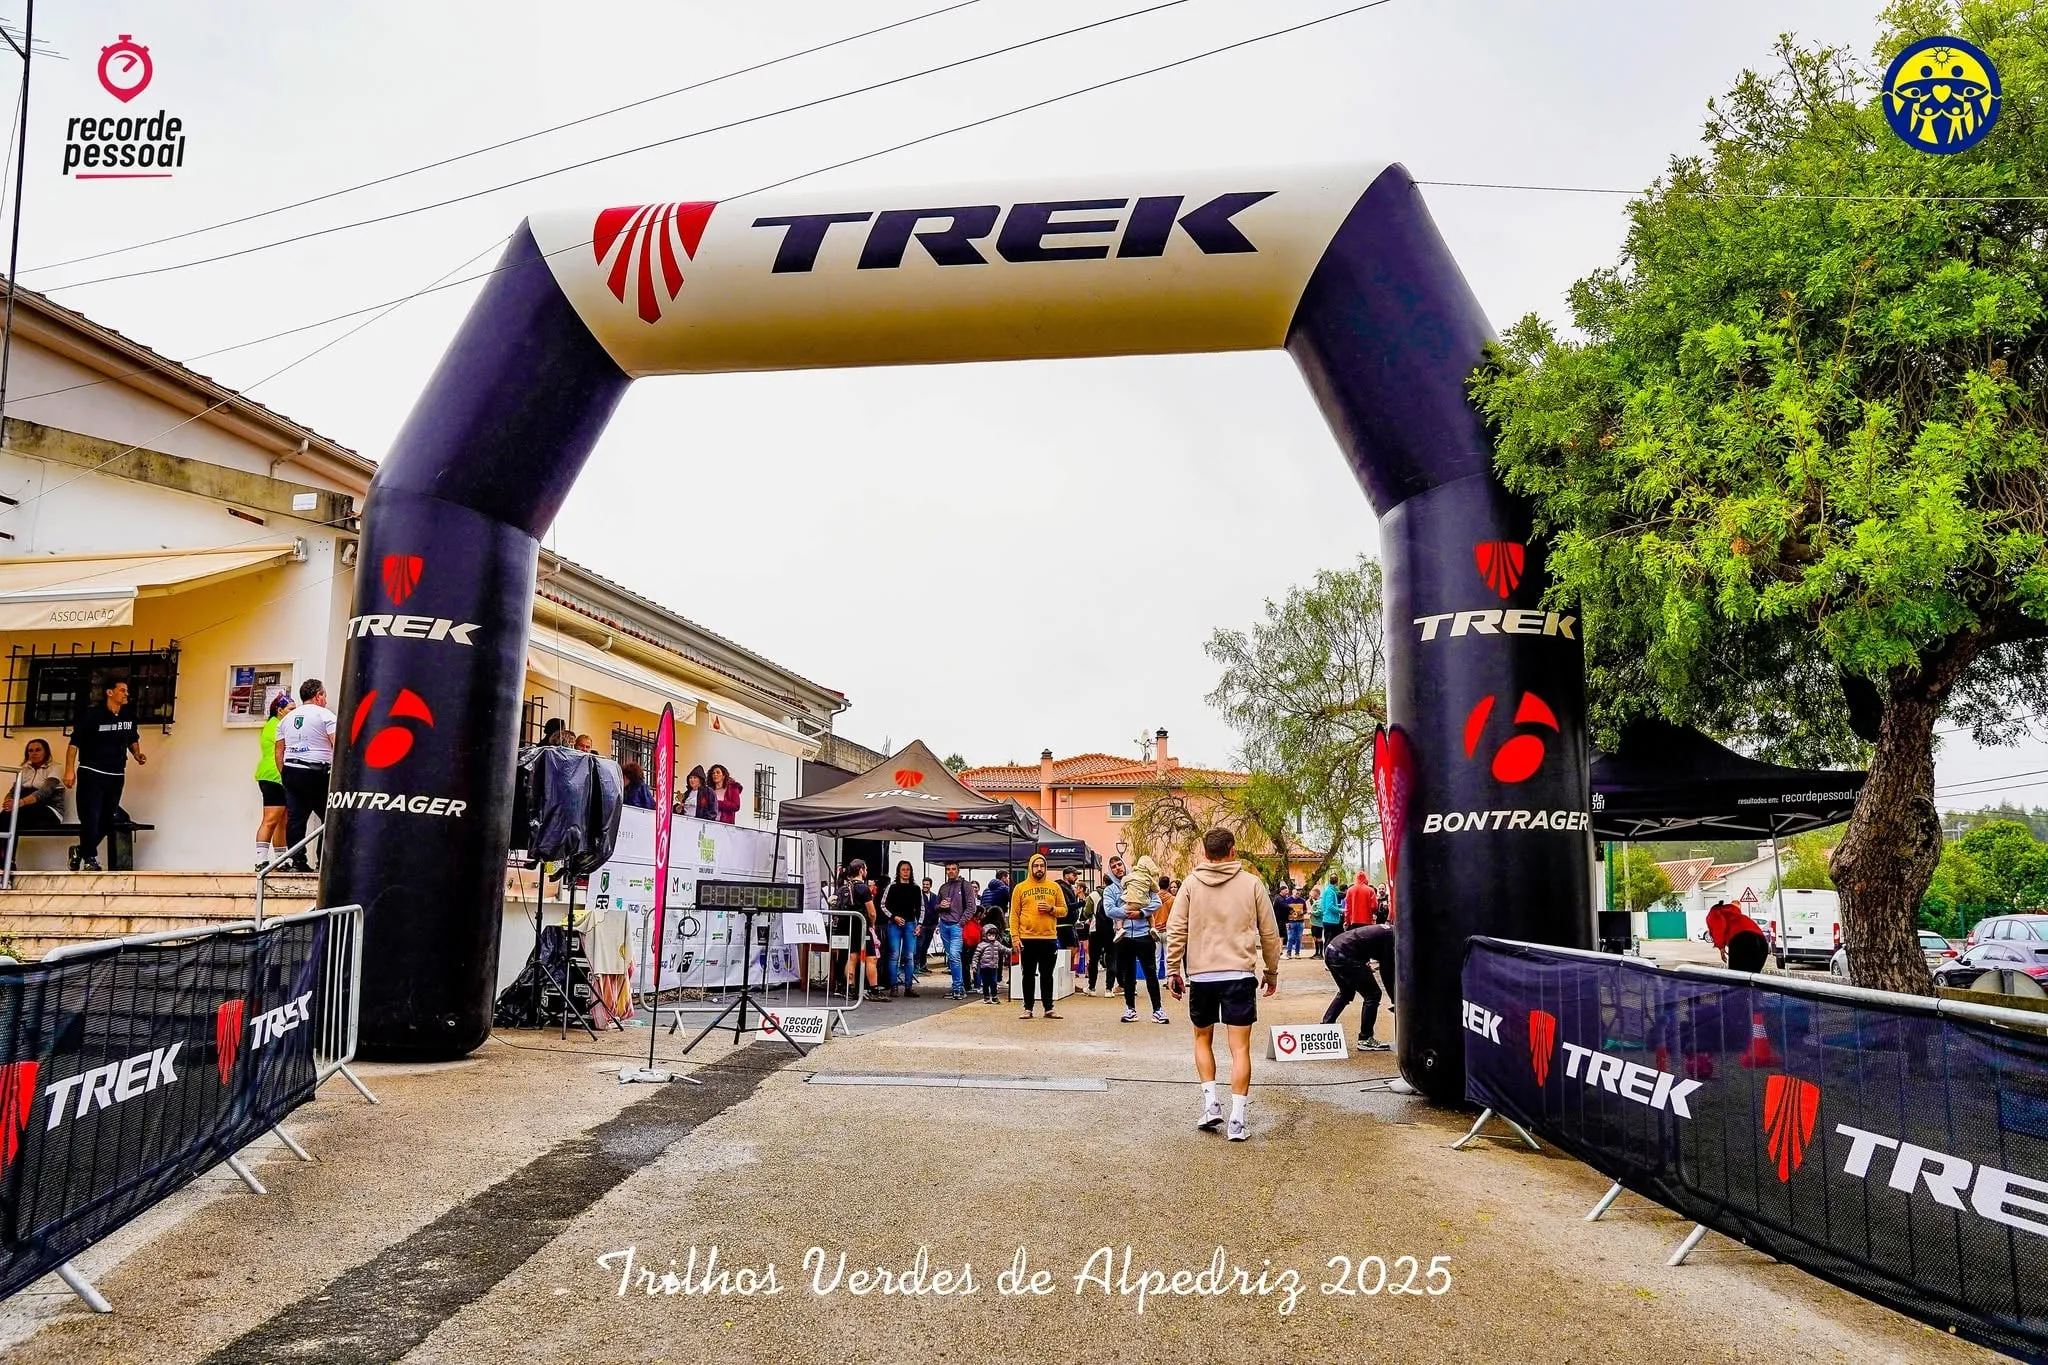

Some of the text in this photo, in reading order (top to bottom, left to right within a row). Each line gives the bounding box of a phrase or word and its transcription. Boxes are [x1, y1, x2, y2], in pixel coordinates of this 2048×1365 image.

[751, 190, 1280, 274] TREK
[1413, 609, 1577, 642] TREK
[326, 791, 467, 818] BONTRAGER
[863, 790, 943, 801] TREK
[1781, 788, 1860, 803] recordepessoal.p
[1423, 811, 1589, 833] BONTRAGER
[796, 922, 820, 934] TRAIL
[249, 990, 313, 1050] TREK
[782, 1024, 822, 1034] pessoal
[784, 1015, 823, 1026] recorde
[1300, 1030, 1339, 1042] recorde
[1301, 1038, 1342, 1053] pessoal
[44, 1041, 184, 1132] TREK
[1562, 1041, 1703, 1119] TREK
[1835, 1123, 2048, 1238] TRE
